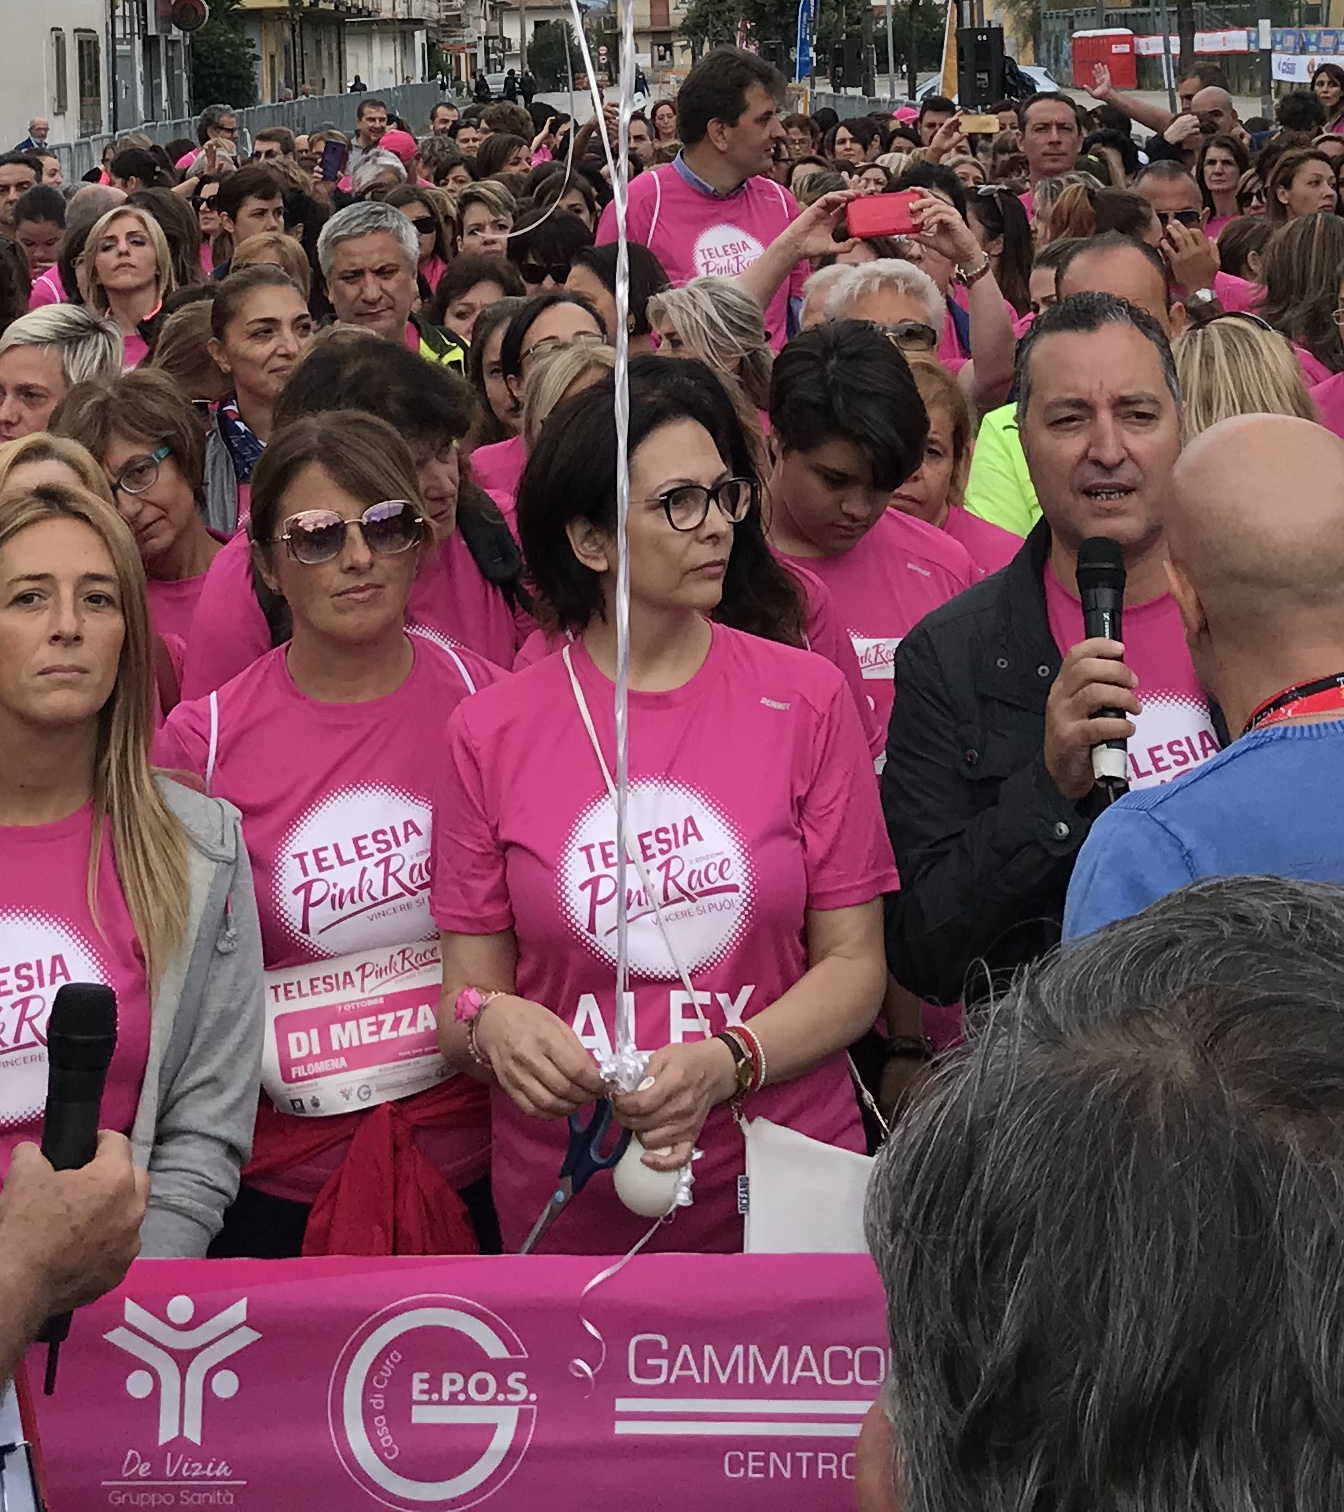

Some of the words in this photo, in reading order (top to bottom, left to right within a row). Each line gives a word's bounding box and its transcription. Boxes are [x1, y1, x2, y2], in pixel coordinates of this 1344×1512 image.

[699, 240, 752, 260] TELESIA
[1126, 729, 1224, 783] LESIA
[291, 818, 424, 878] TELESIA
[292, 866, 380, 936] Pink
[656, 854, 734, 904] Race
[269, 970, 356, 1003] TELESIA
[356, 954, 399, 994] Pink
[397, 946, 439, 972] Race
[287, 1028, 322, 1060] DI
[329, 1003, 438, 1052] MEZZA
[291, 1056, 348, 1079] FILOMENA
[372, 1349, 403, 1389] Cura
[628, 1333, 893, 1386] GAMMACO
[368, 1393, 385, 1409] di
[412, 1371, 538, 1402] E.P.O.S.
[373, 1414, 400, 1461] Casa
[121, 1448, 152, 1478] De
[165, 1451, 233, 1479] Vizia
[108, 1490, 175, 1508] Gruppo
[179, 1489, 234, 1505] Sanità
